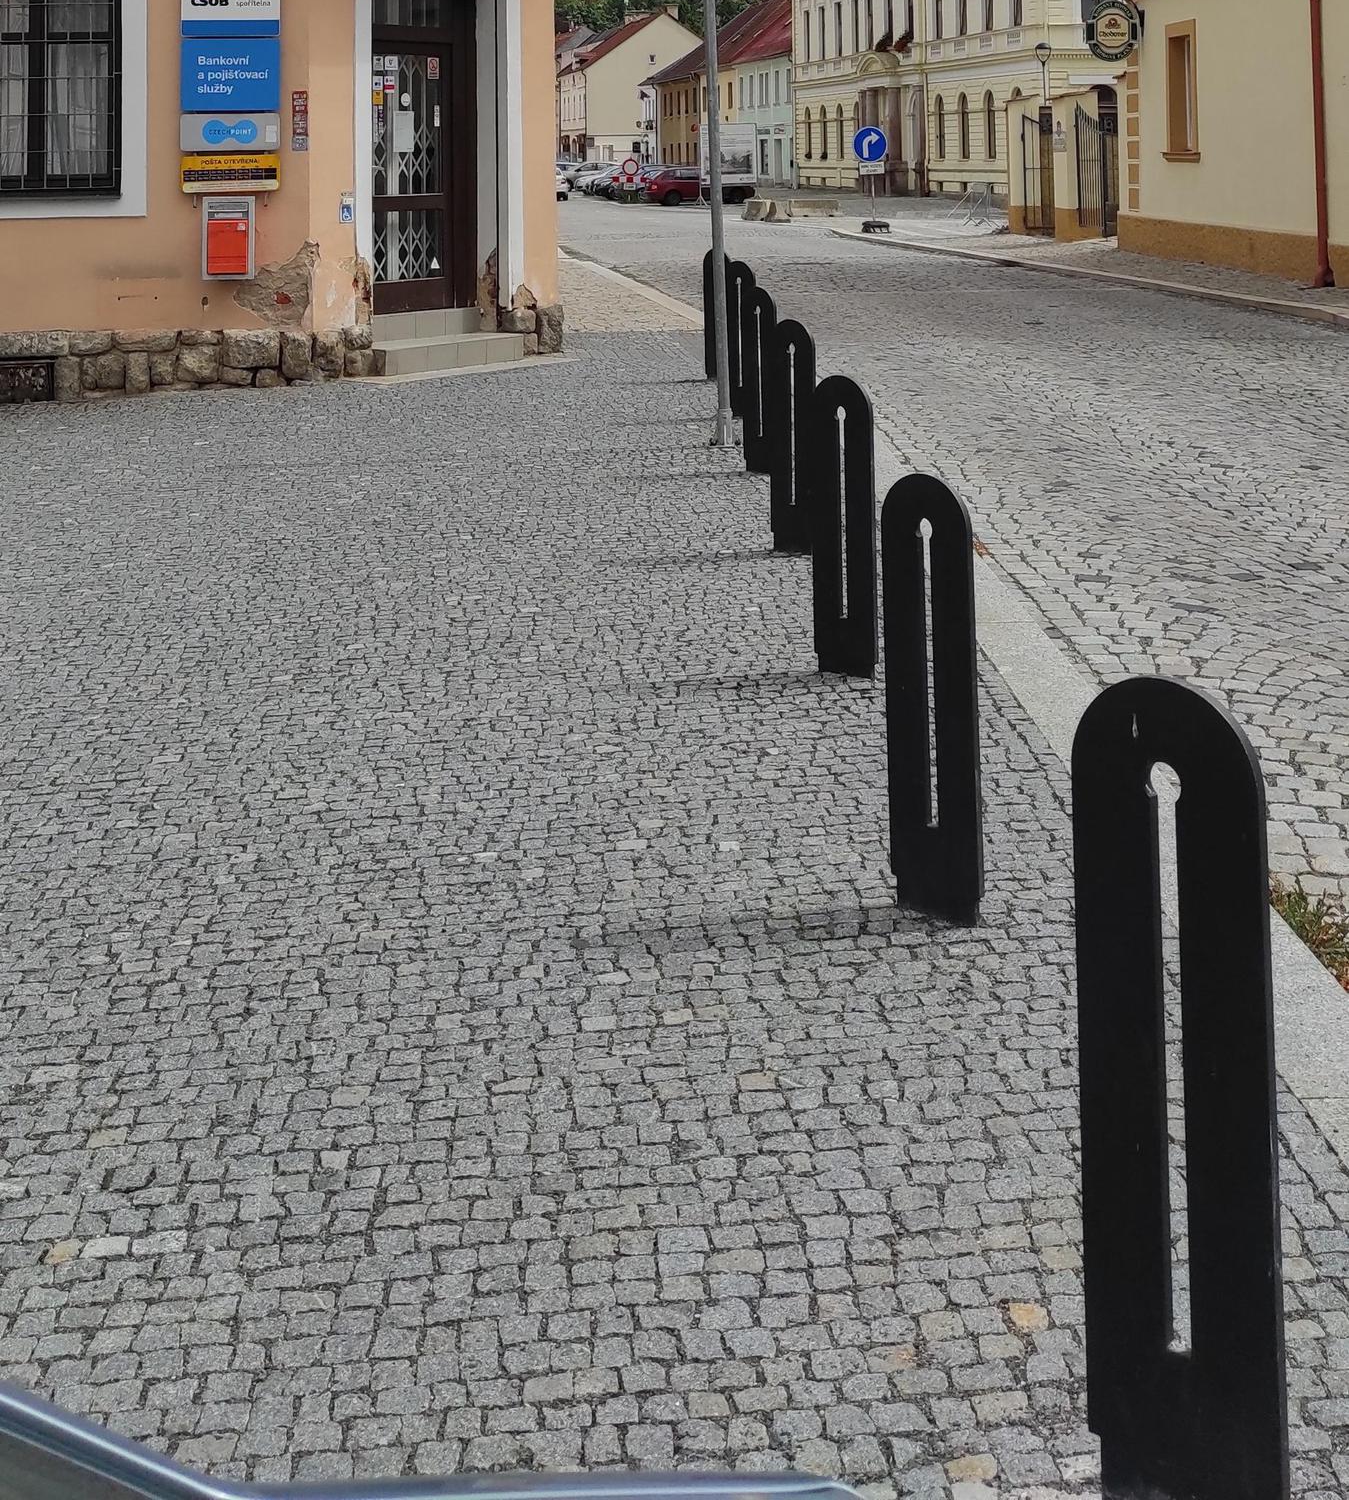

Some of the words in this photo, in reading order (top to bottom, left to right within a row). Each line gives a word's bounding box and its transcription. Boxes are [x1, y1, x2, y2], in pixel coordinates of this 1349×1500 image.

[235, 0, 271, 8] spořitelna
[197, 55, 250, 66] Bankovní
[197, 72, 205, 80] a
[207, 69, 269, 81] pojišťovací
[197, 83, 234, 95] služby
[200, 158, 223, 166] POŠTA
